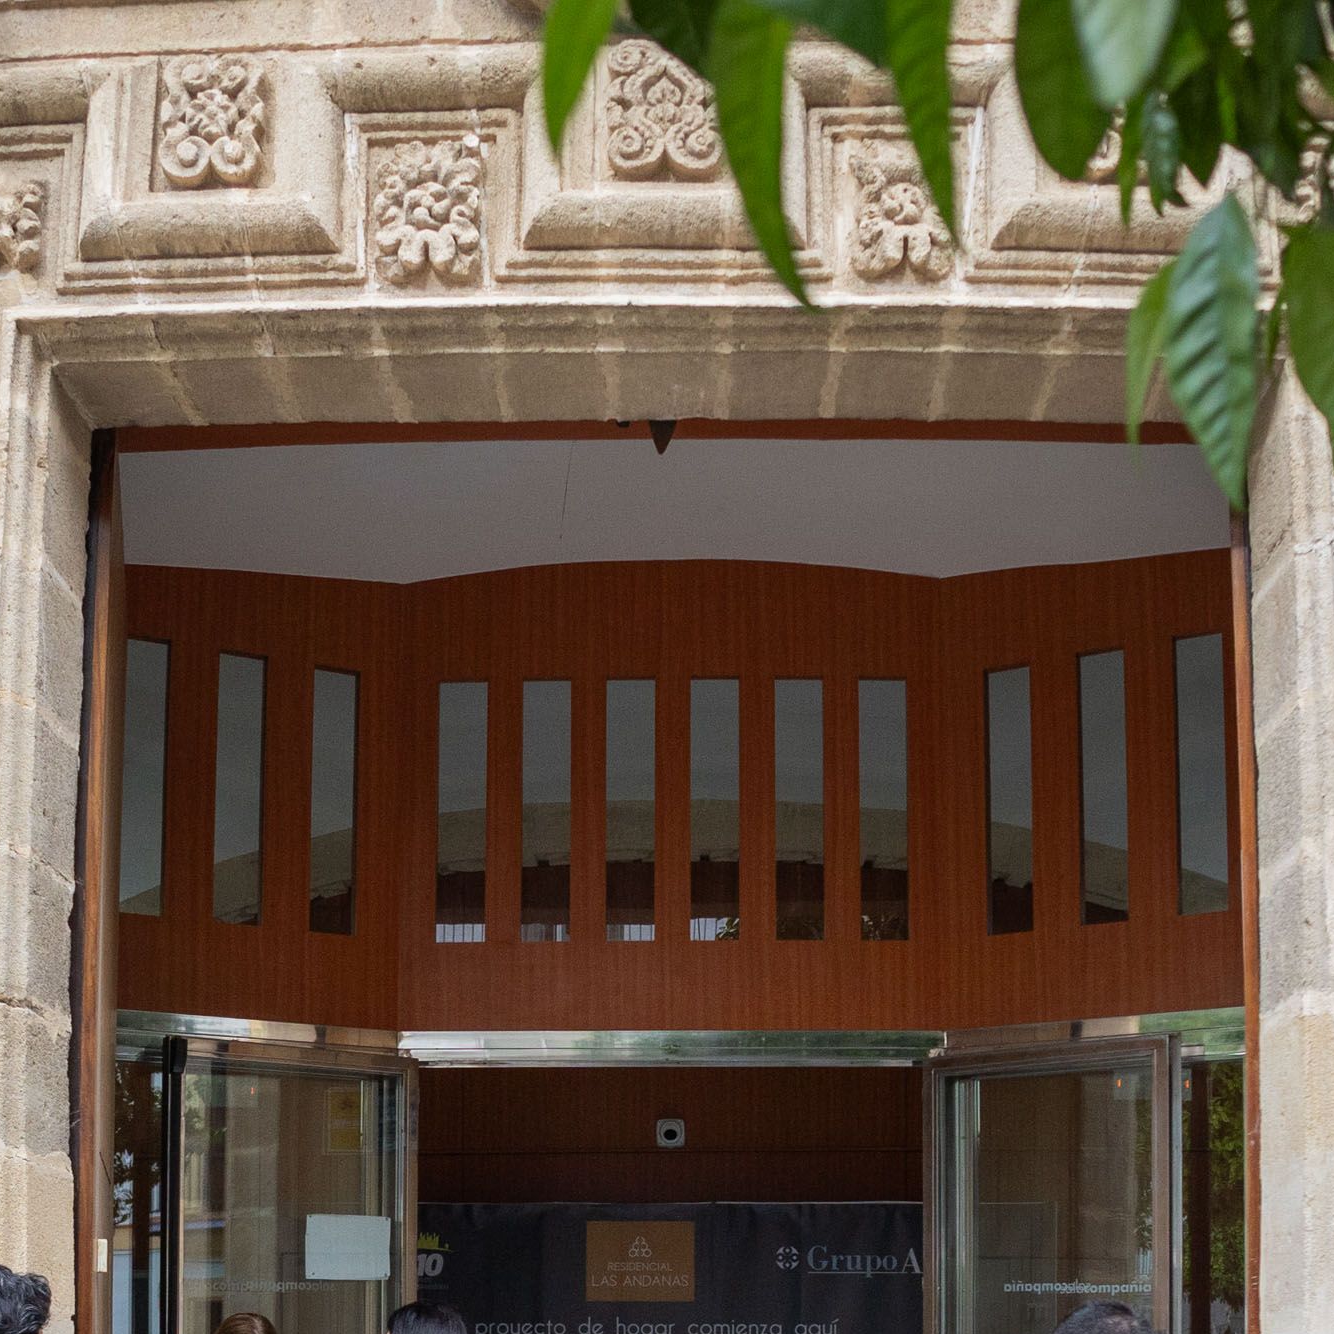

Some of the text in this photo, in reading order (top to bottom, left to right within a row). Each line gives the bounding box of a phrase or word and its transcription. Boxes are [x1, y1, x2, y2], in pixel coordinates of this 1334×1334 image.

[607, 1261, 673, 1272] RESIDENCIAL
[591, 1274, 689, 1288] LAS ANDANAS
